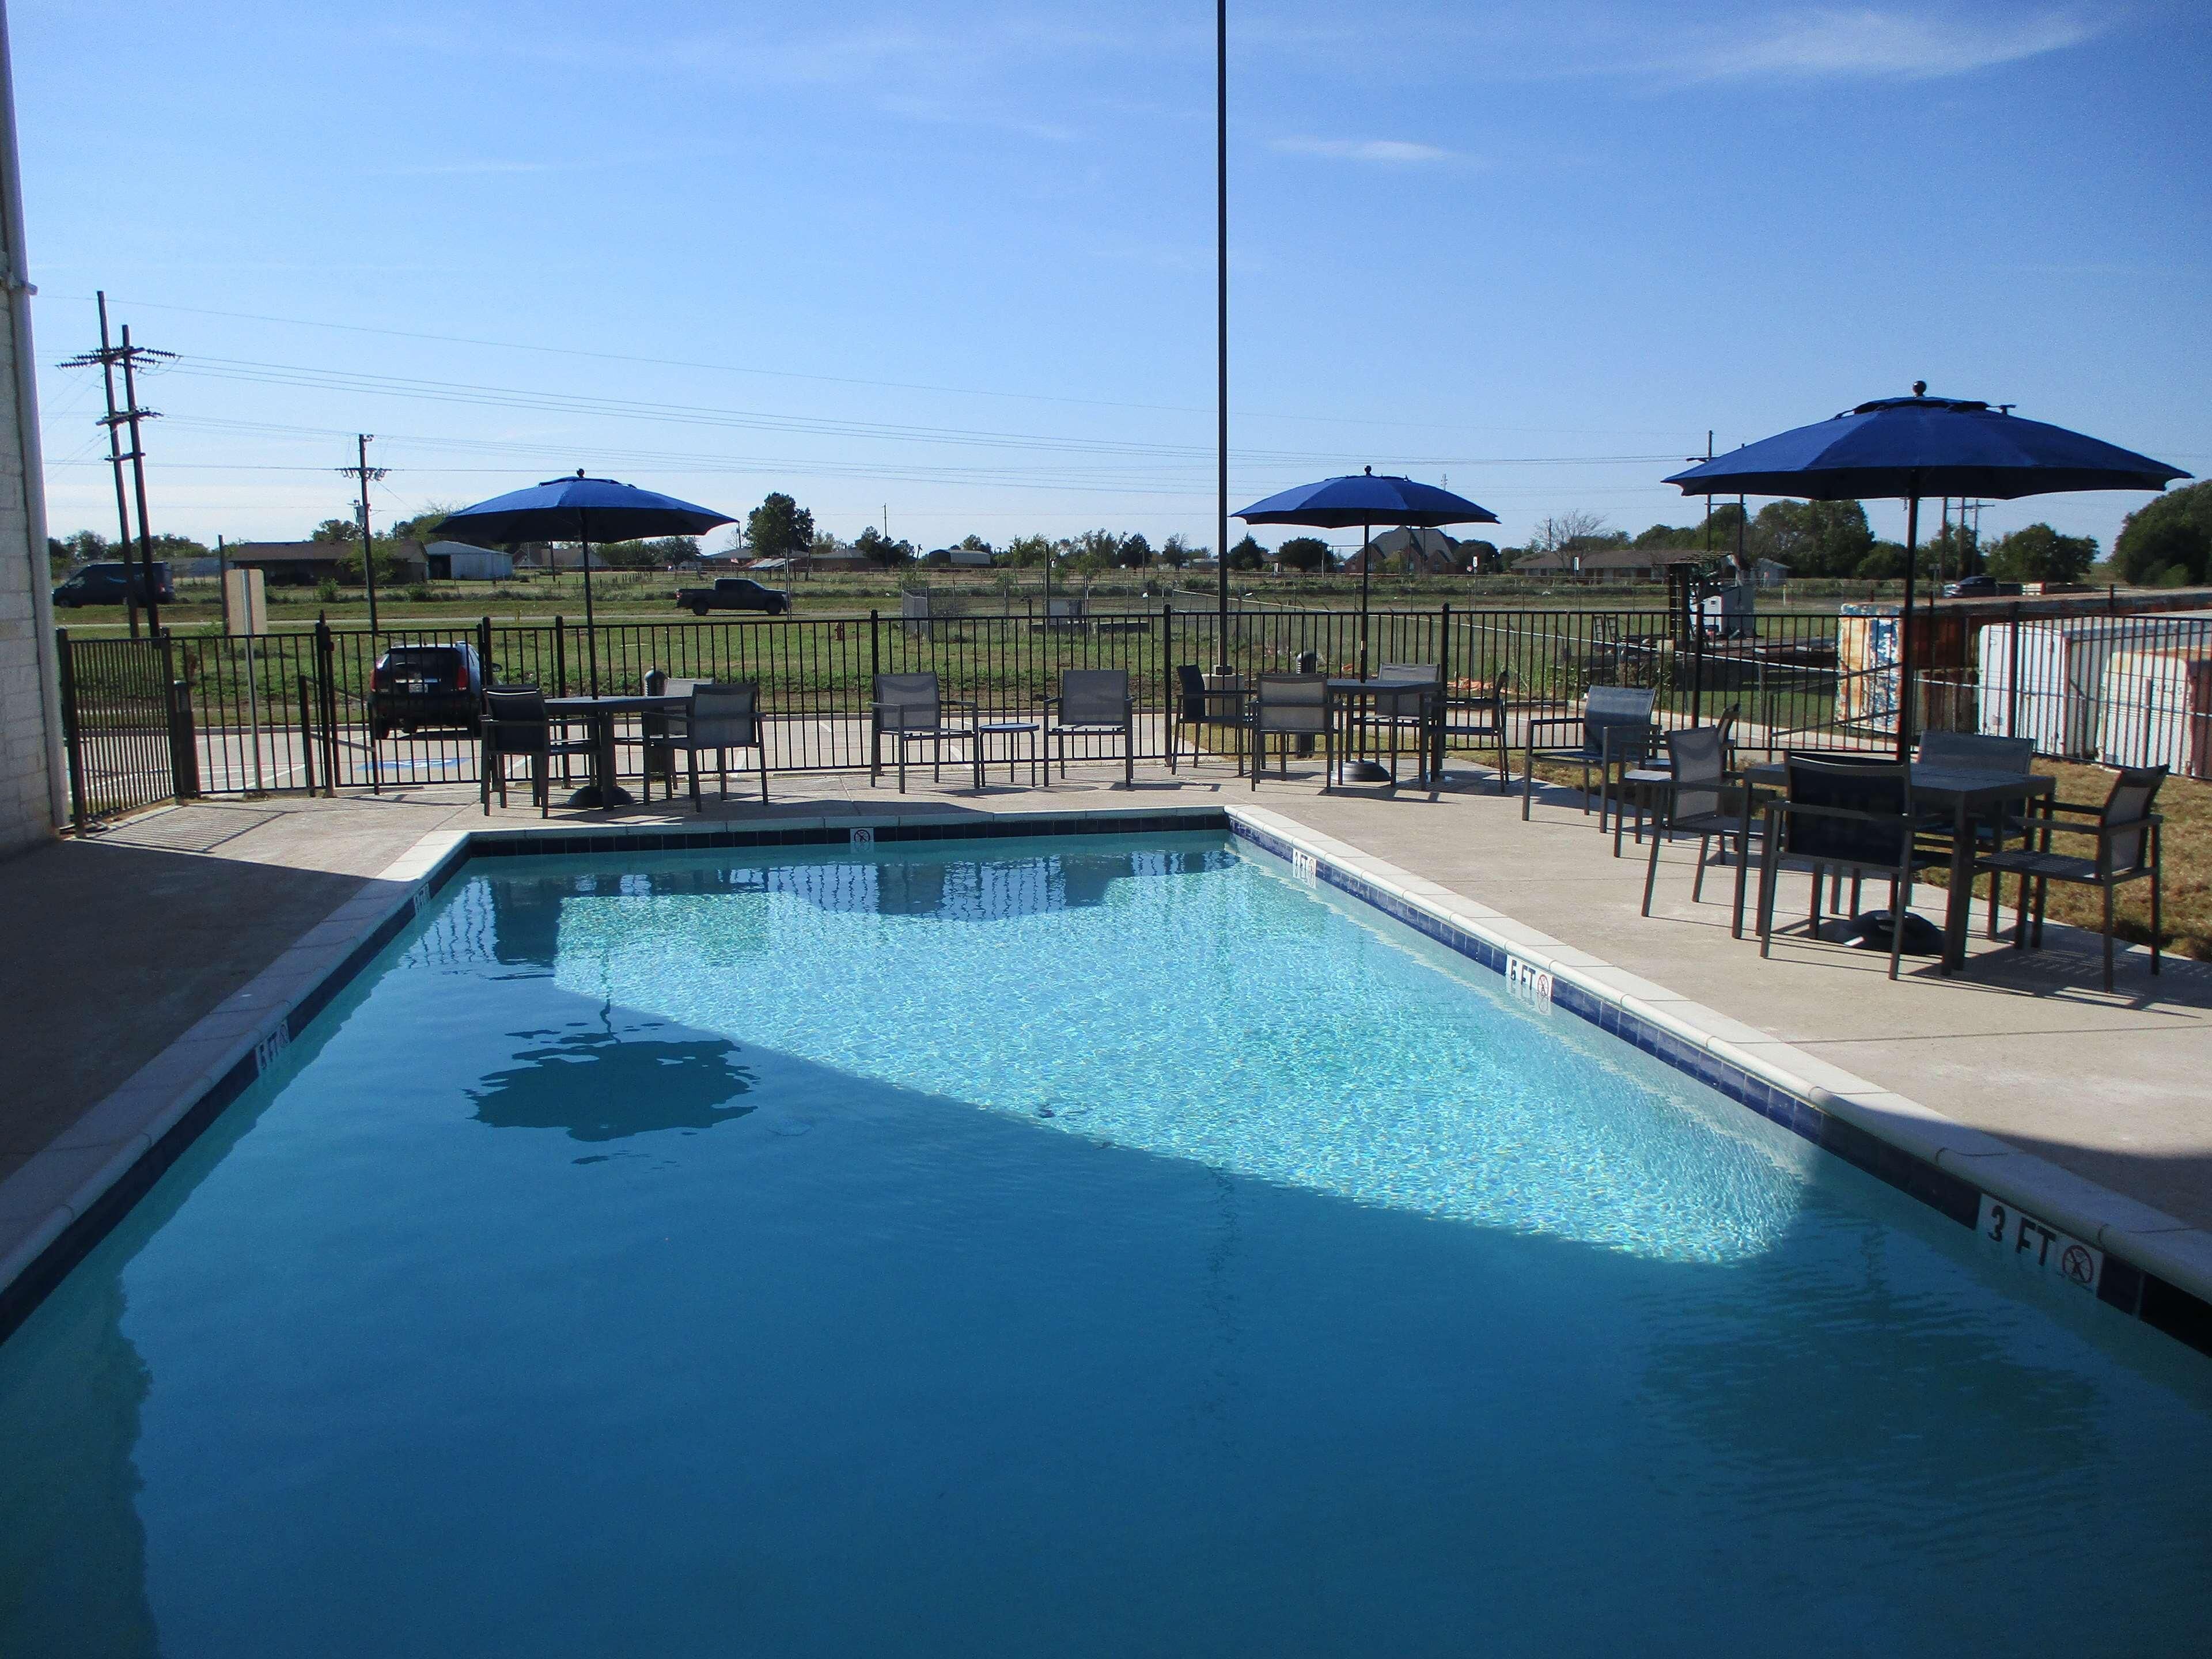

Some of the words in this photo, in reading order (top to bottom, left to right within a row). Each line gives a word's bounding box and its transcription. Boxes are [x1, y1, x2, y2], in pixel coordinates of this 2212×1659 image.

[1521, 964, 1536, 990] FT
[1988, 1205, 2005, 1242] 3
[2016, 1217, 2056, 1266] FT
